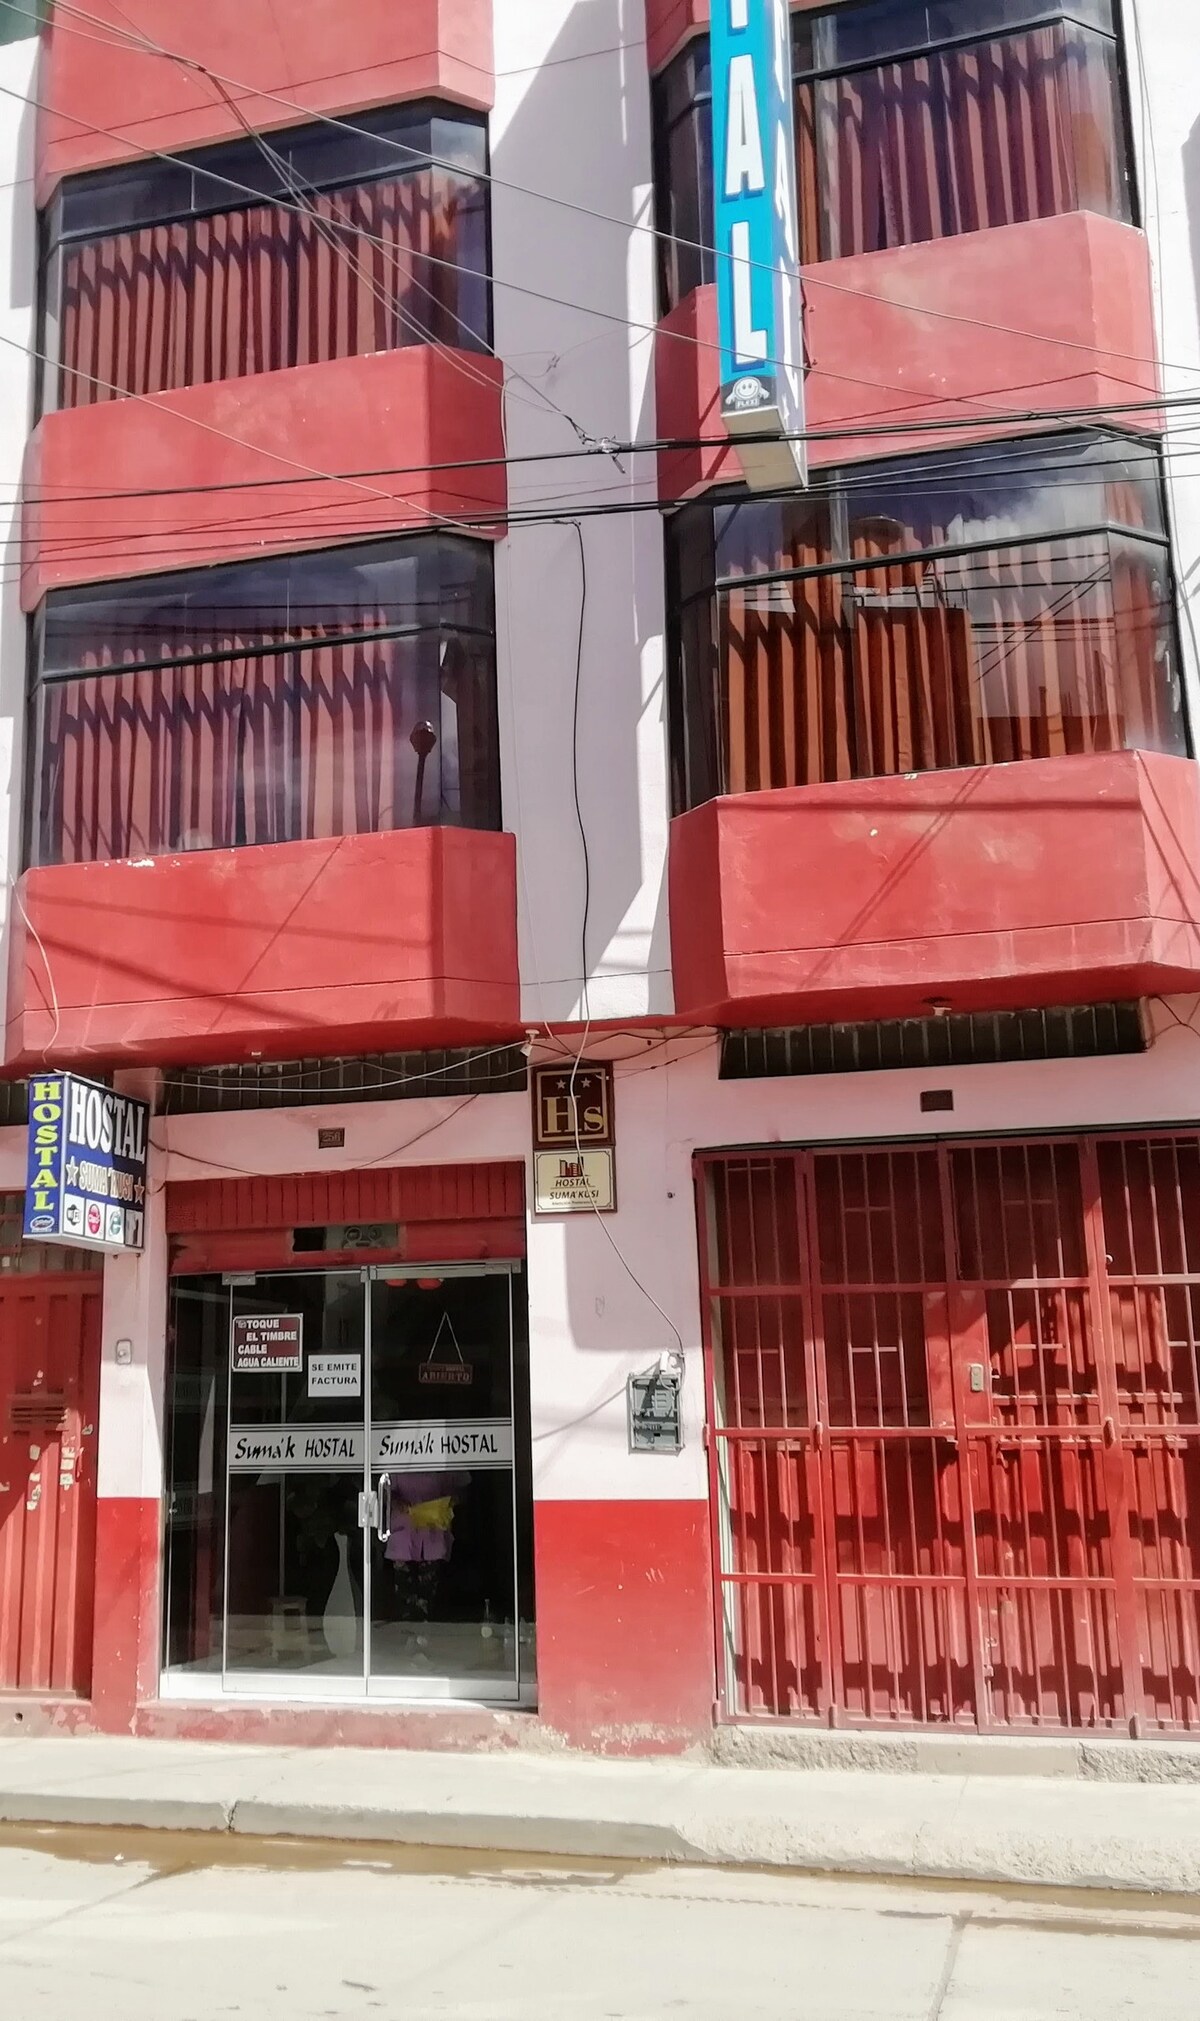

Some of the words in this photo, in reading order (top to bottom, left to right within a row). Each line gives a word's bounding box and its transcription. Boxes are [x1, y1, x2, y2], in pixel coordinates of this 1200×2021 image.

[724, 0, 768, 366] AL
[543, 1095, 605, 1134] Hs
[69, 1082, 146, 1163] HOSTAL
[31, 1081, 62, 1211] HOSTAL
[555, 1178, 591, 1187] HOSTAL
[246, 1318, 280, 1329] TOQUE
[246, 1332, 259, 1342] EL
[260, 1331, 297, 1342] TIMBRE
[237, 1344, 268, 1355] CABLE
[237, 1357, 260, 1368] AGUA
[260, 1356, 299, 1367] CALIENTE
[311, 1363, 324, 1372] SE
[327, 1362, 357, 1371] EMITE
[311, 1376, 358, 1385] FACTURA
[304, 1438, 355, 1458] HOSTAL
[440, 1434, 498, 1454] HOSTAL
